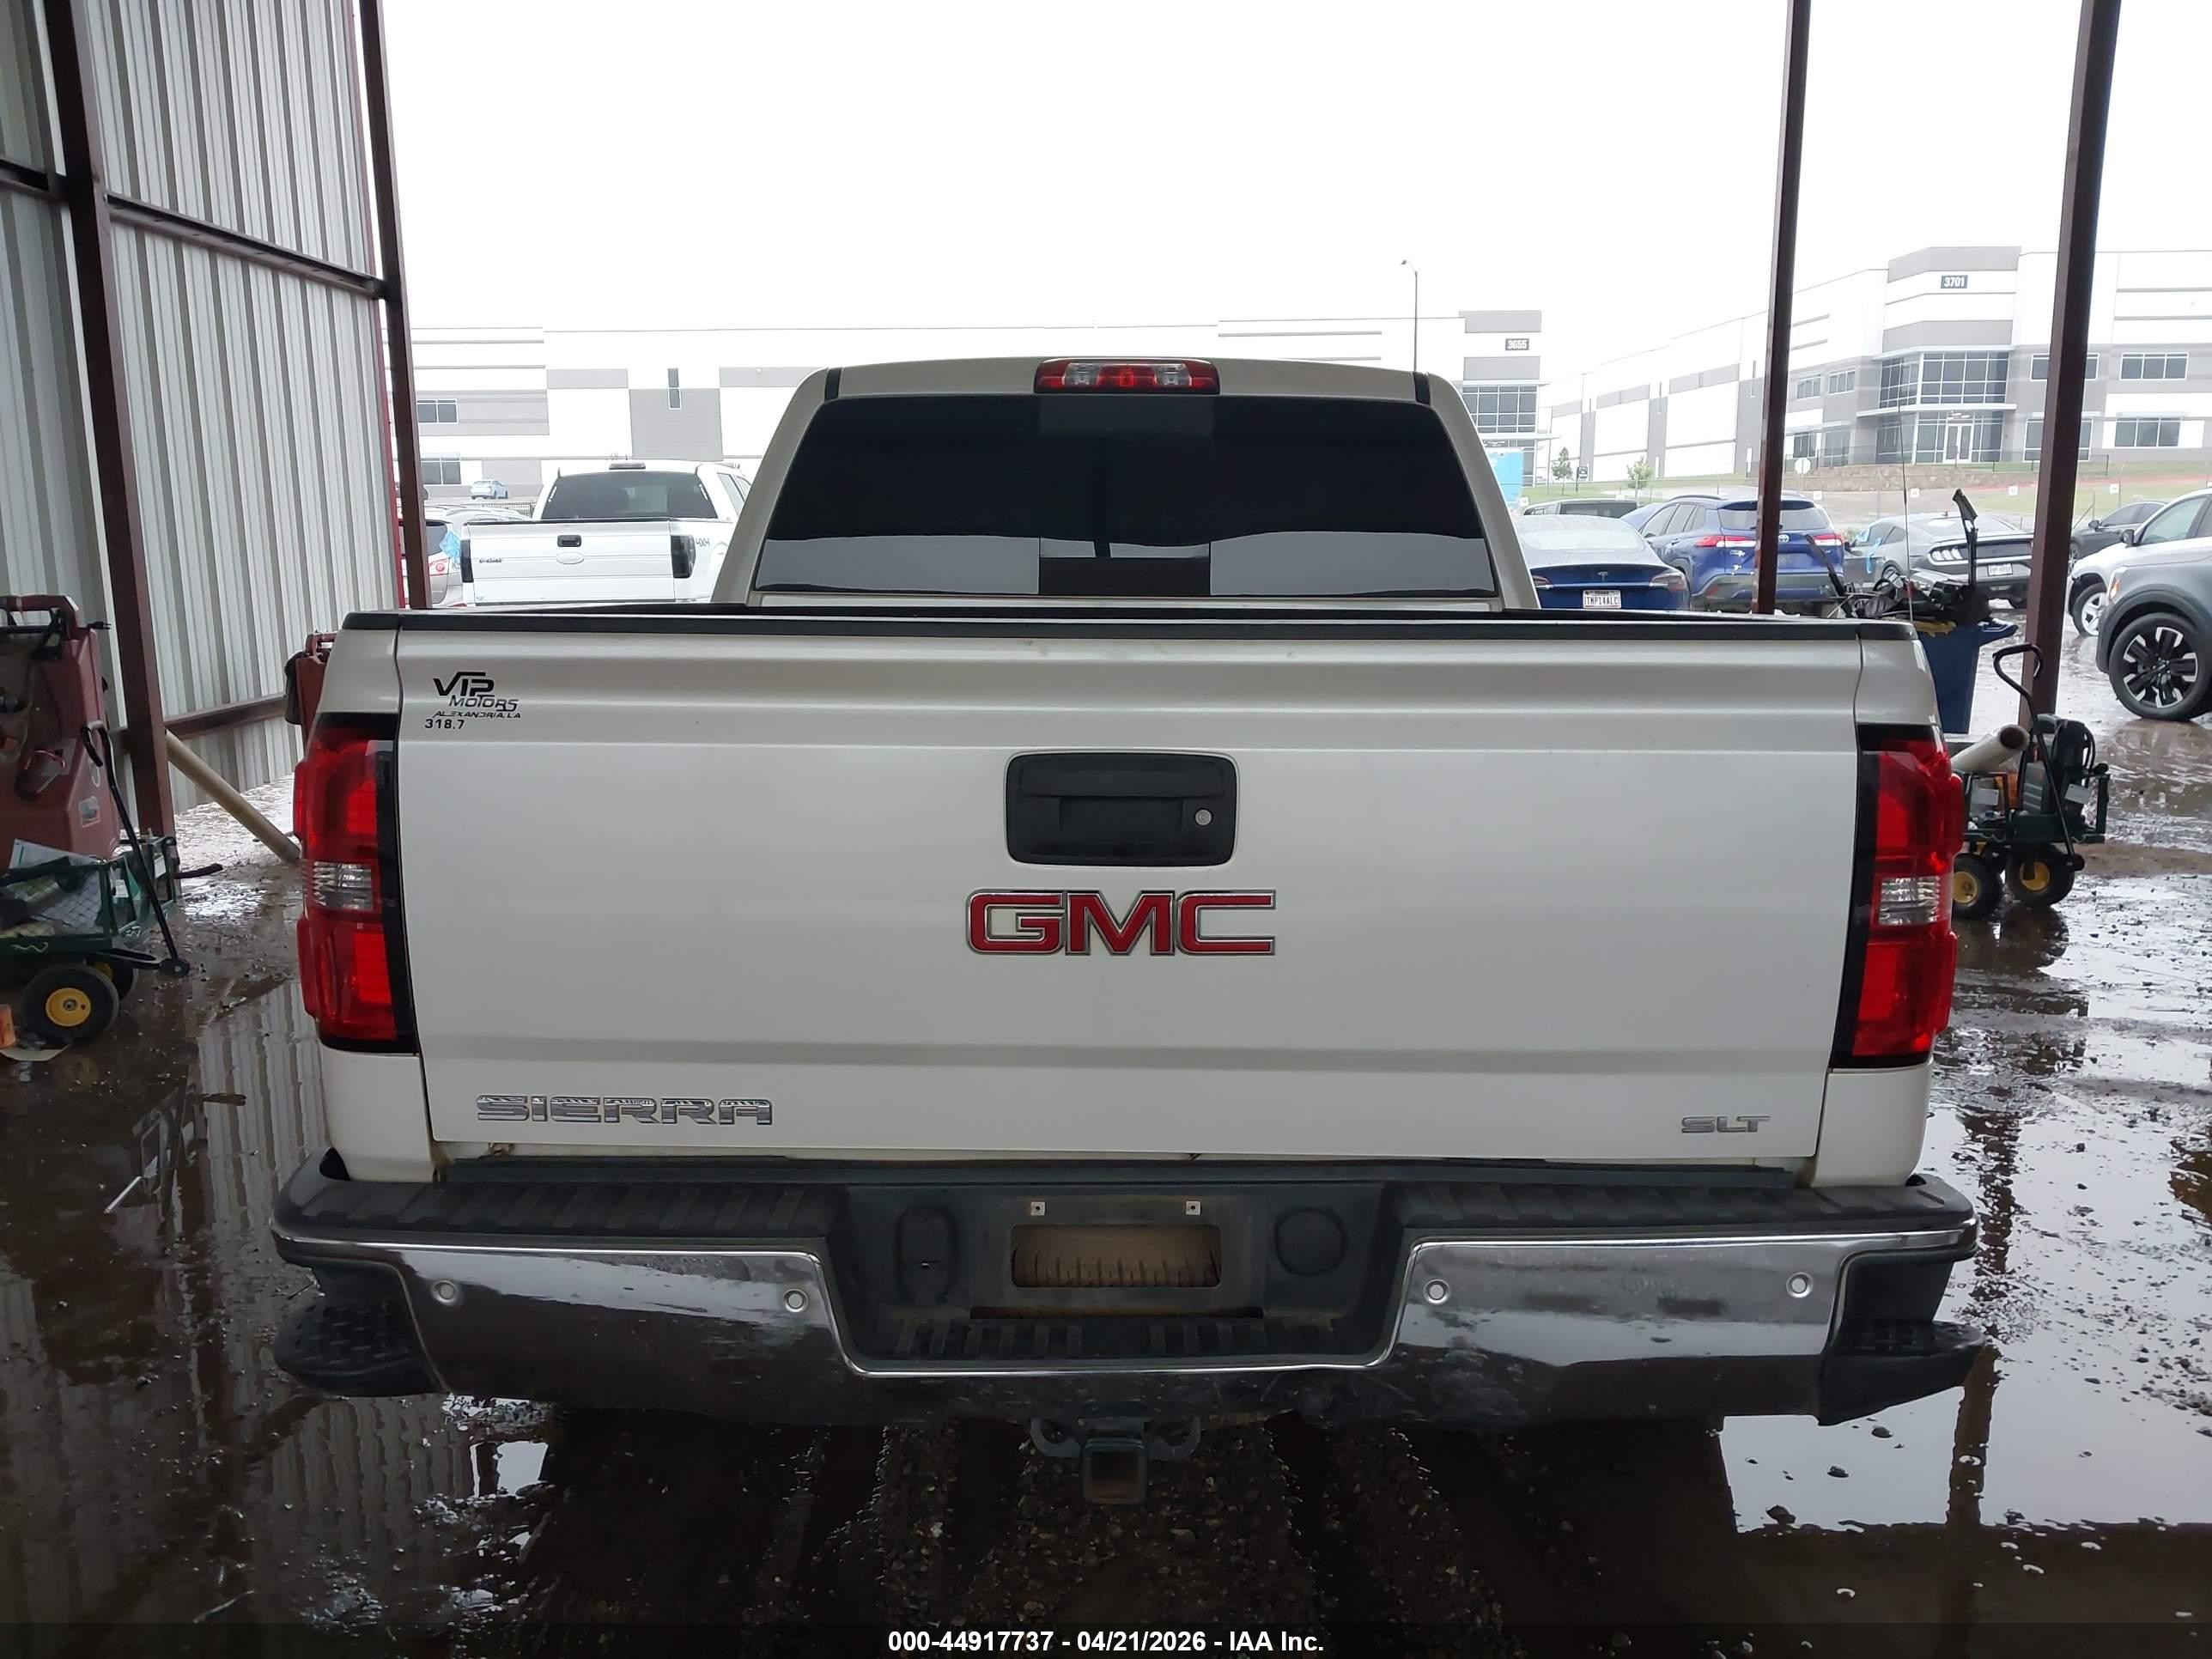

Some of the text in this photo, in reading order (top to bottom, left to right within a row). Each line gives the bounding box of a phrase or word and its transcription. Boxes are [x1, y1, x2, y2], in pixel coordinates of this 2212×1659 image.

[1943, 276, 1966, 288] 3701
[433, 672, 495, 697] VIP
[448, 695, 520, 712] MOTORS
[424, 719, 465, 730] 318.7
[966, 889, 1276, 956] GMC
[476, 1095, 773, 1125] SIERRA
[1681, 1115, 1771, 1133] SLT
